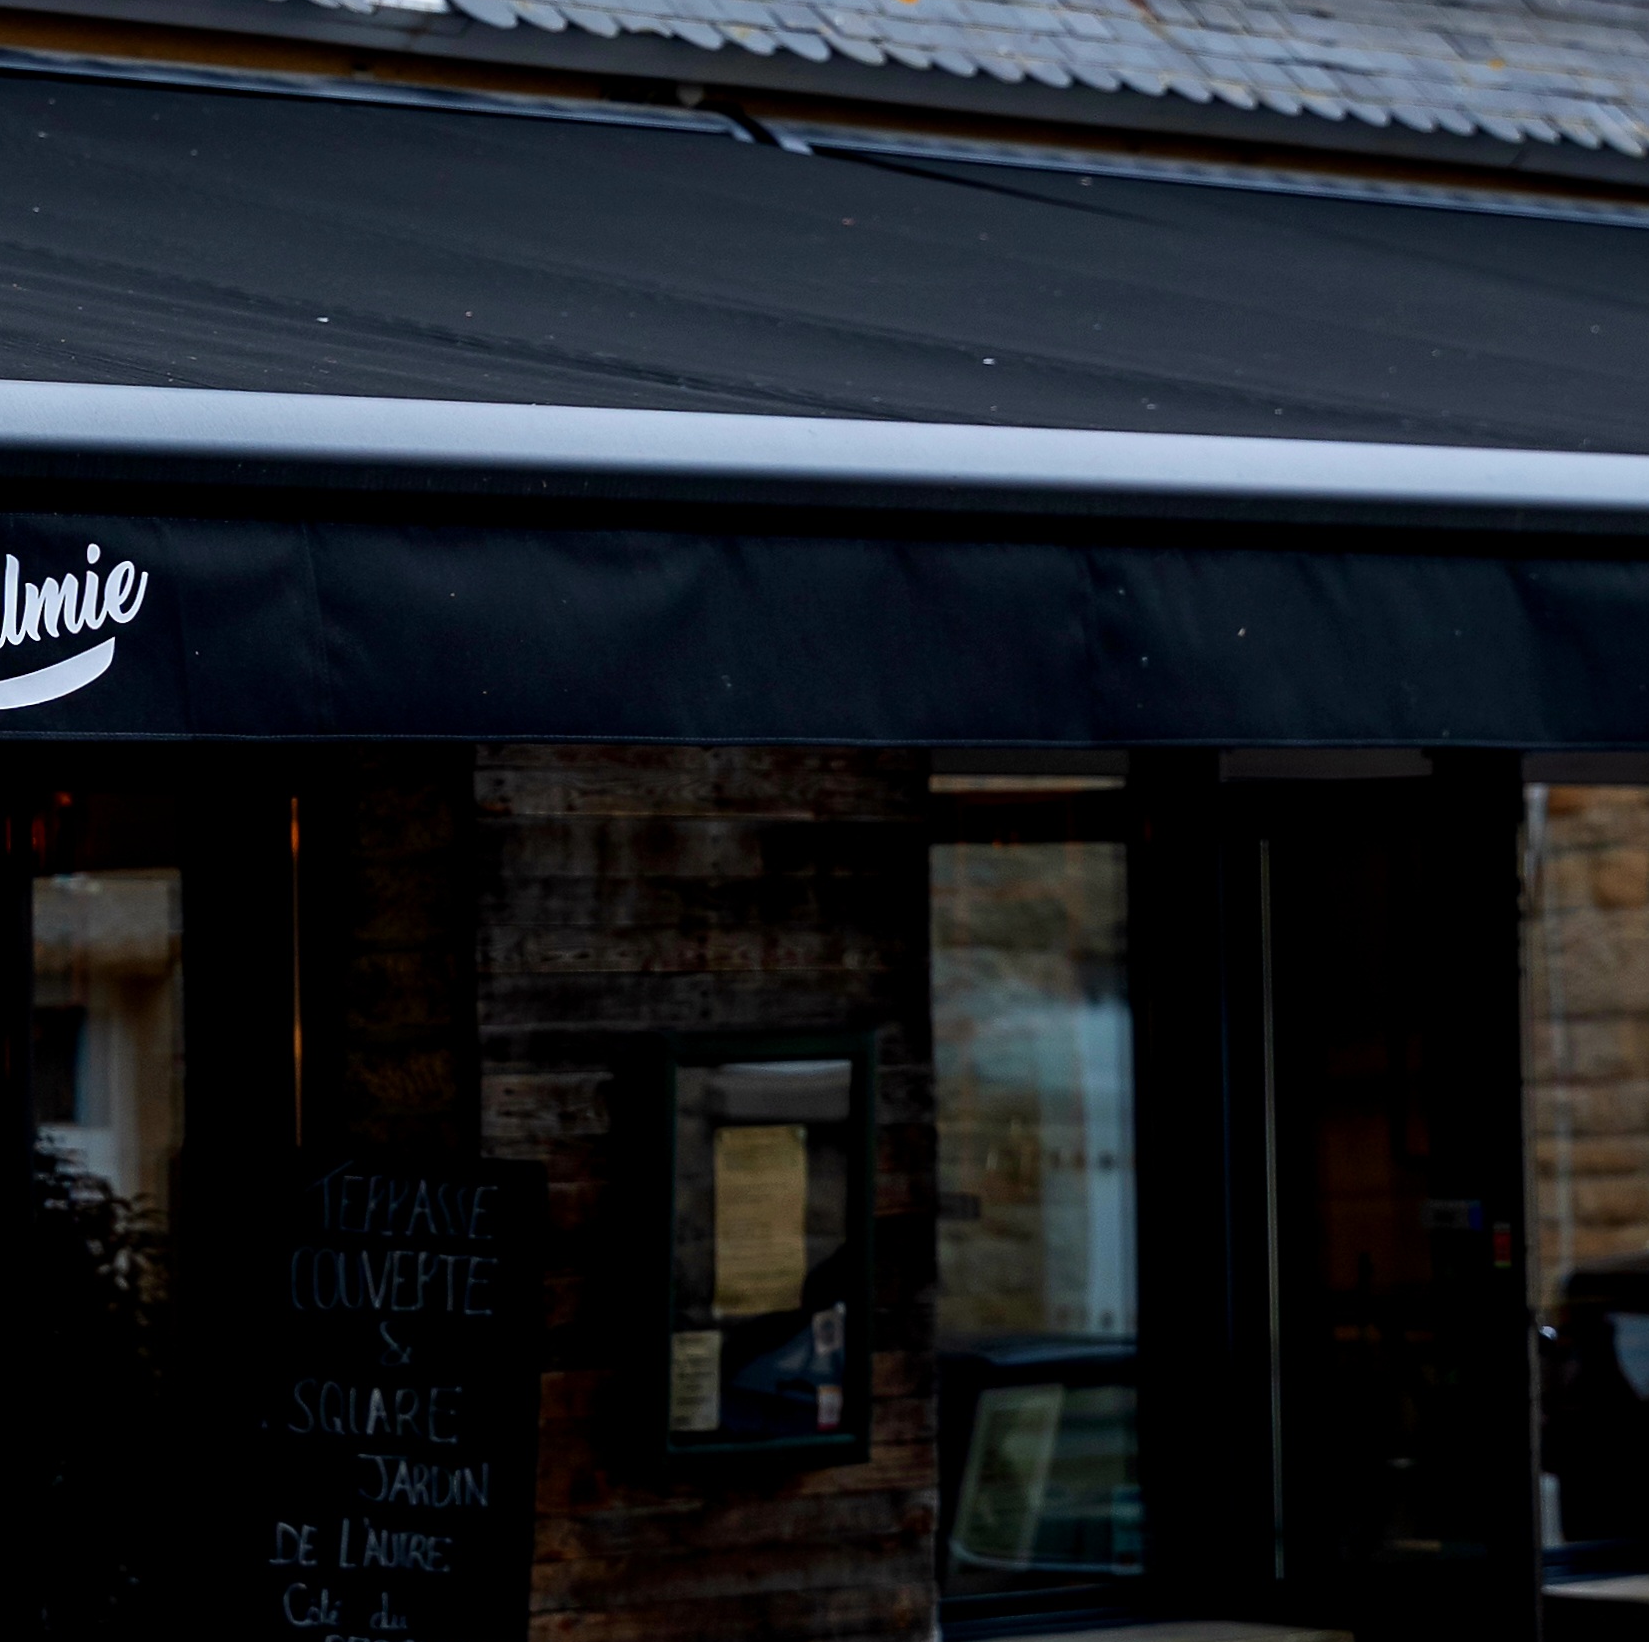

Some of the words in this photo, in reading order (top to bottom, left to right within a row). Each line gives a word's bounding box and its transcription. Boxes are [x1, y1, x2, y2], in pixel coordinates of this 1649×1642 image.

[290, 1245, 499, 1316] COUVERTE
[378, 1319, 413, 1367] &
[286, 1377, 463, 1445] SQUARE
[356, 1452, 490, 1508] JARDIN
[268, 1520, 319, 1567] DE
[368, 1590, 411, 1631] du
